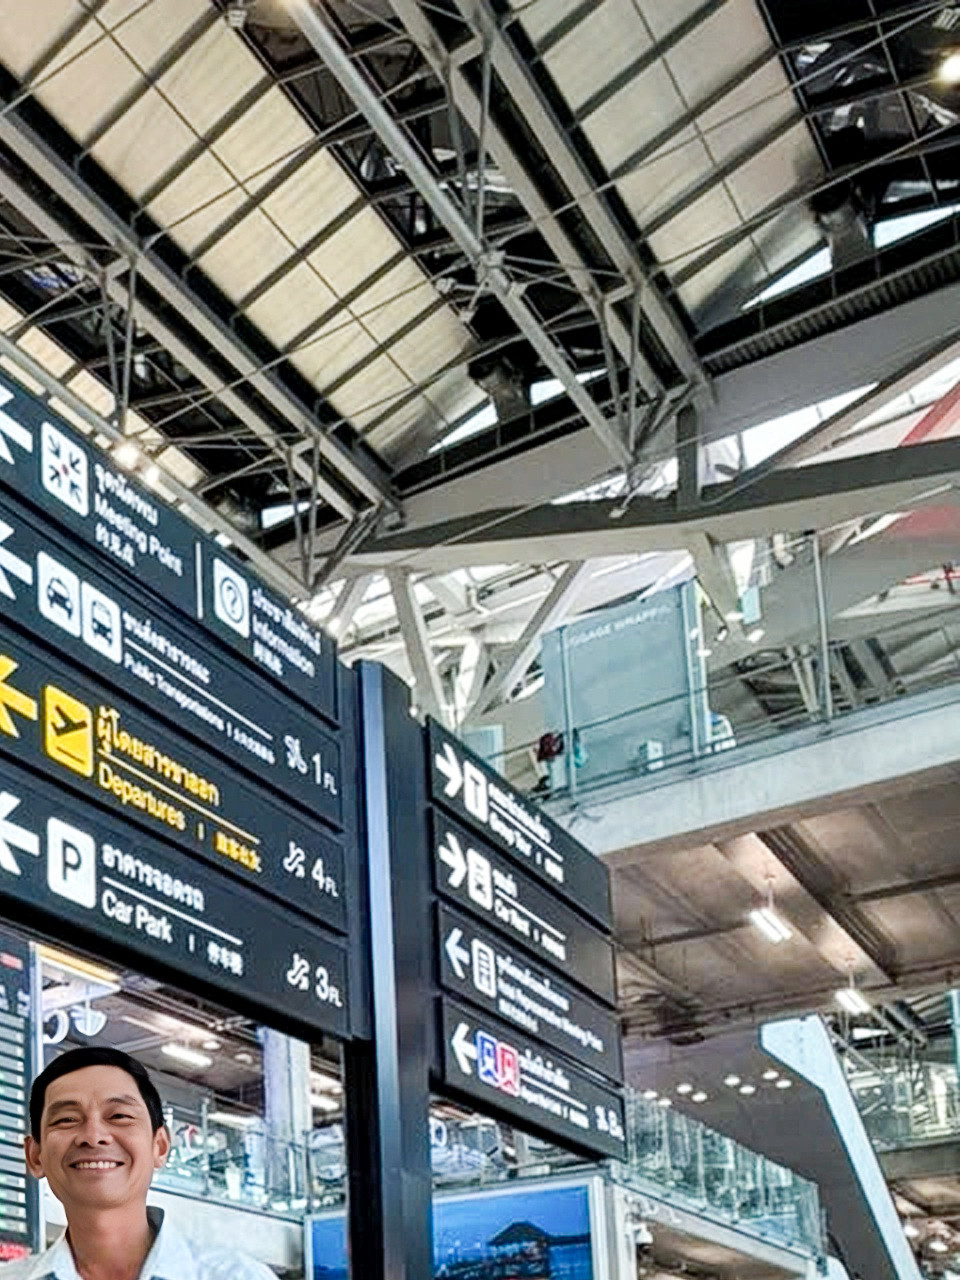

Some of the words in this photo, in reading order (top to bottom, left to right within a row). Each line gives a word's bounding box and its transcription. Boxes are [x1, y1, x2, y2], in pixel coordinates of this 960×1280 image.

[95, 493, 147, 554] Meeting
[149, 535, 182, 577] Point
[253, 614, 315, 677] Information
[97, 706, 220, 808] ผู้โดยสารขาออก
[99, 762, 186, 830] Departures
[102, 844, 205, 912] อาคารจอดรถ
[102, 889, 134, 925] Car
[136, 904, 173, 943] Park
